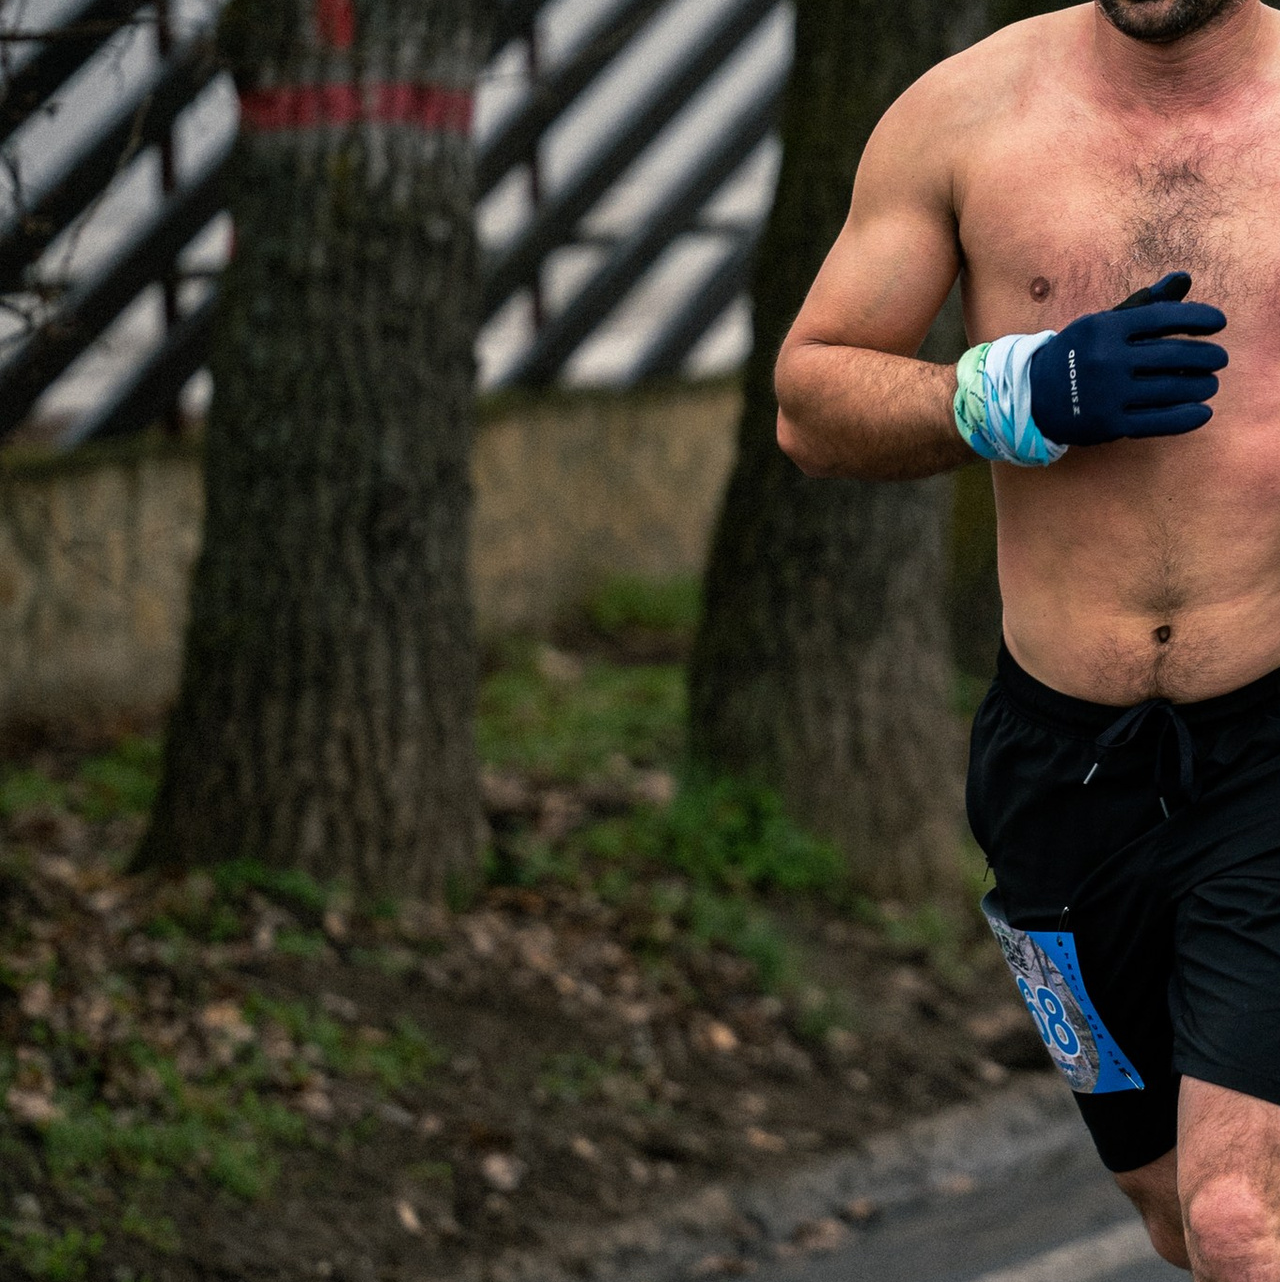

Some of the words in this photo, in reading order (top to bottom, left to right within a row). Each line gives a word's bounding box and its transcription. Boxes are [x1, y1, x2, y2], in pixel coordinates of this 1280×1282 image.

[1068, 349, 1079, 404] SIMOND
[1064, 952, 1084, 1002] TRAIL
[1087, 1014, 1104, 1039] RUN
